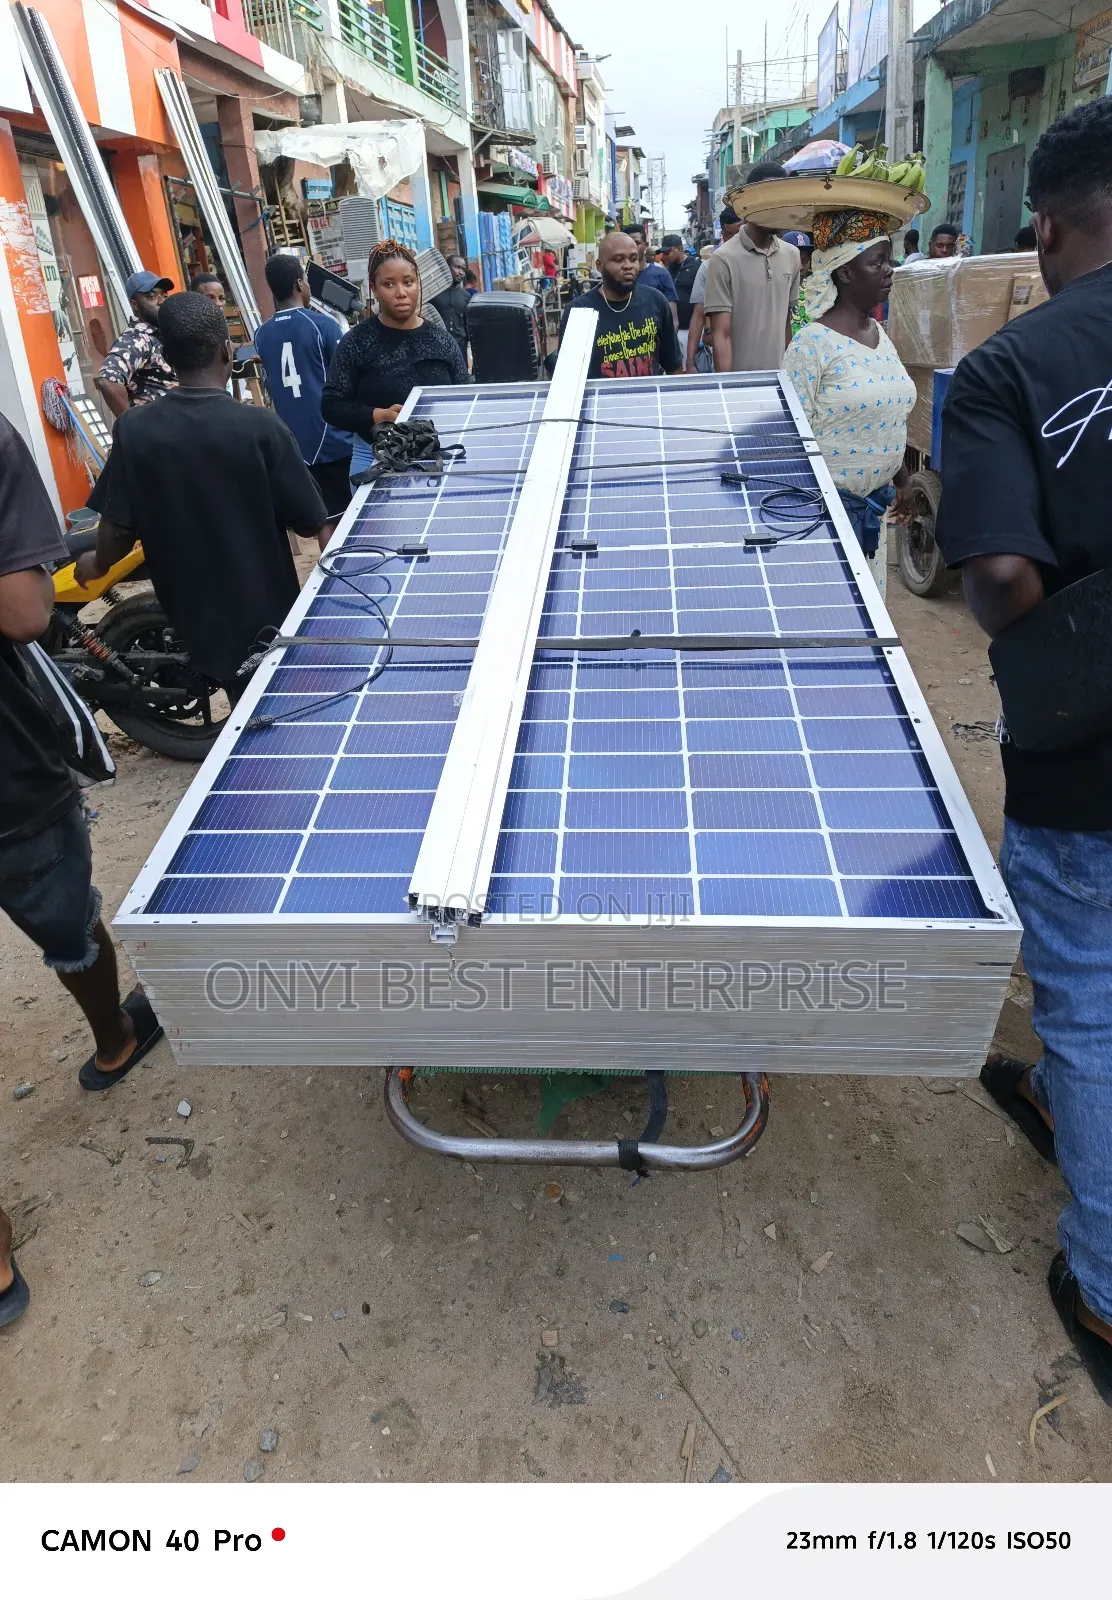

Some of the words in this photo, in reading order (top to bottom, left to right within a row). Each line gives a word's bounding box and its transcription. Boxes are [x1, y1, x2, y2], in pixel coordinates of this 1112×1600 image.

[309, 219, 319, 229] TO
[320, 216, 331, 228] LET
[79, 275, 101, 294] PUSH
[89, 291, 99, 307] IN
[281, 341, 302, 398] 4
